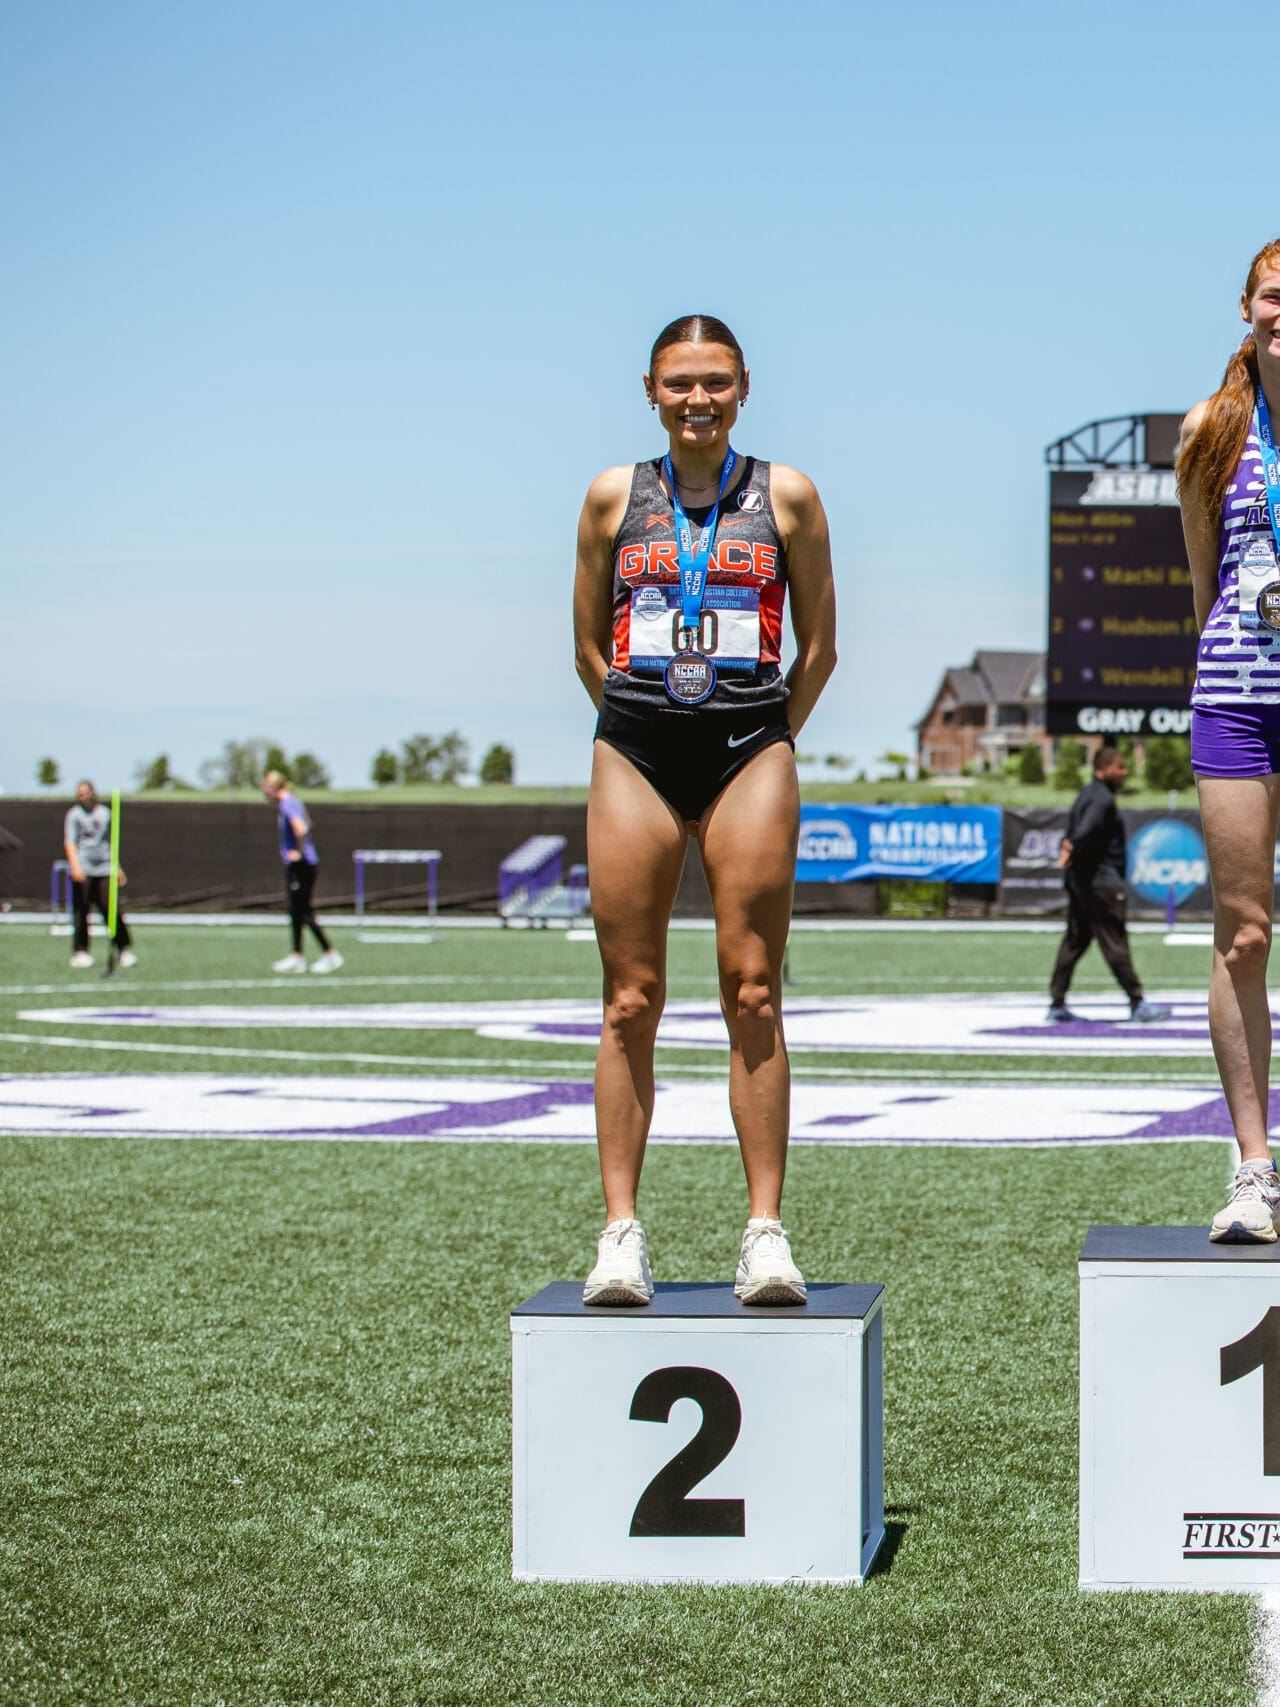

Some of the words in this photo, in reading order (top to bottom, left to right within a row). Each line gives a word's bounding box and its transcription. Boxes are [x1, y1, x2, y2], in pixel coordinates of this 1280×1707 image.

[1267, 463, 1279, 486] NCCAA
[680, 528, 690, 552] NCCAA
[700, 528, 711, 552] NCCAA
[691, 571, 703, 596] NCCAA
[726, 589, 749, 598] COLLEGE
[640, 592, 662, 601] NCCAA
[706, 599, 741, 609] ASSOCIATION
[674, 665, 707, 677] NCCAA
[1077, 707, 1146, 732] GRAY
[869, 822, 987, 848] NATIONAL
[1130, 859, 1208, 885] NCAA
[629, 1366, 746, 1537] 2
[1182, 1523, 1280, 1549] FIRST
